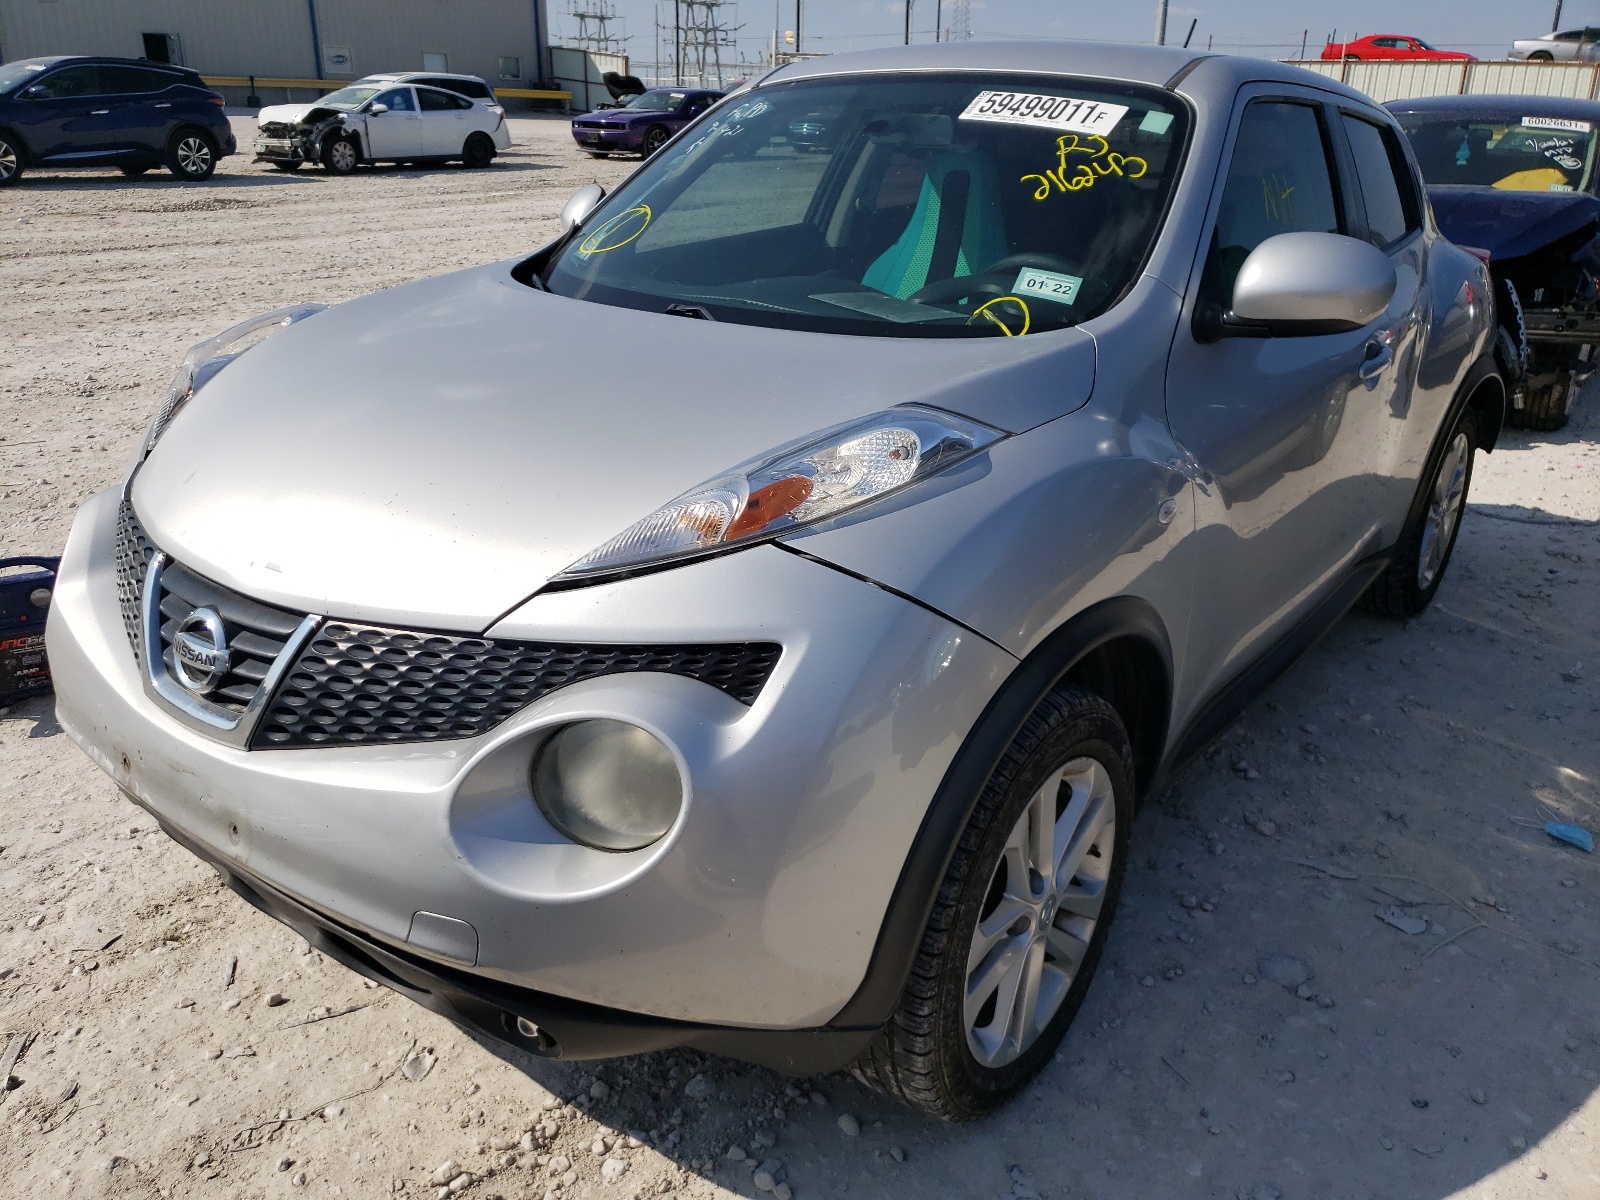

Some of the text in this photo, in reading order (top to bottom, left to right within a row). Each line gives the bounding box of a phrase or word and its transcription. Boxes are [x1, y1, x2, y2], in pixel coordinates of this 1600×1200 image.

[978, 93, 1100, 124] 59499011
[1027, 278, 1045, 289] 01
[1052, 283, 1072, 295] 22
[174, 637, 217, 667] NISSAN
